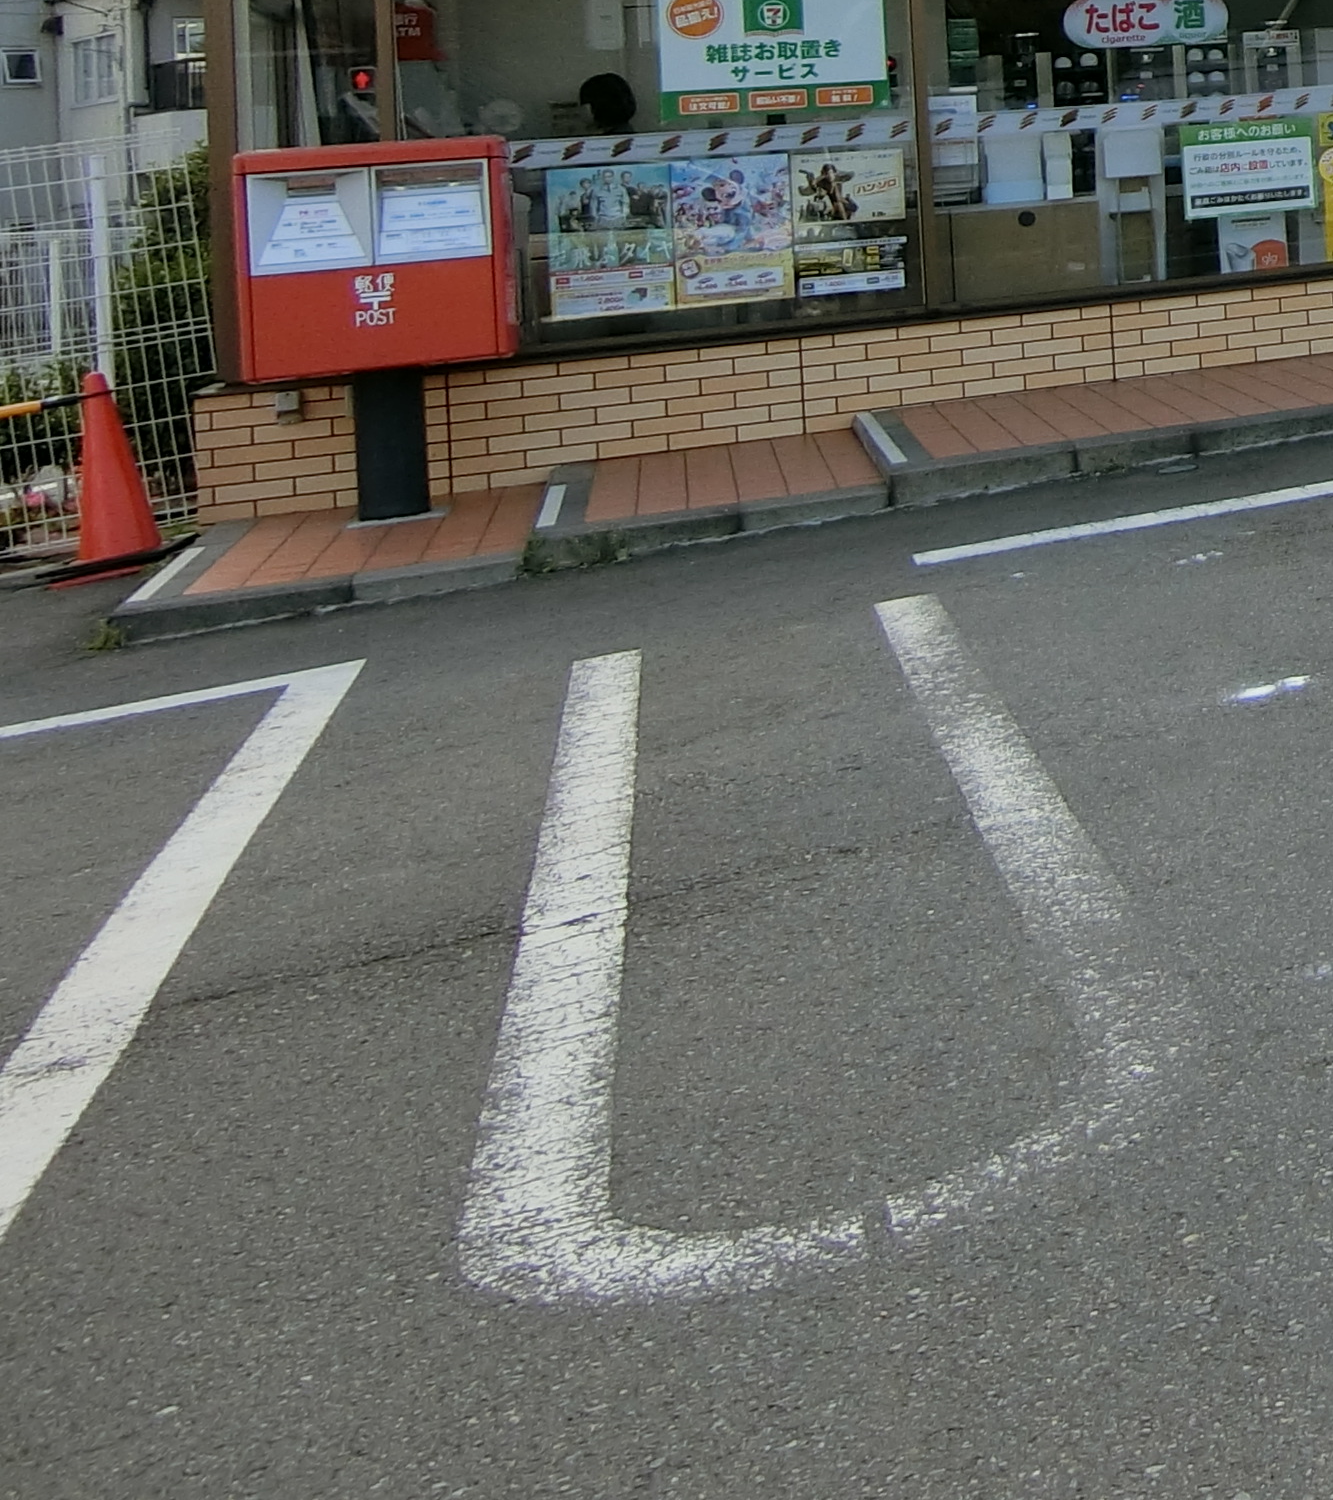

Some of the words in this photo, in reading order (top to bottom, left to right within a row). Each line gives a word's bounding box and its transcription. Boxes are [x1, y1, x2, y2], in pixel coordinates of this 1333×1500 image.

[1085, 1, 1160, 34] たばこ
[1173, 0, 1206, 29] 酒
[1101, 33, 1146, 44] cigarette
[706, 39, 842, 64] 雑誌お取置き
[730, 63, 819, 83] サービス
[1198, 122, 1296, 141] お客様へのお願い
[1261, 252, 1278, 266] glo
[354, 273, 395, 294] 郵便
[355, 308, 397, 327] POST
